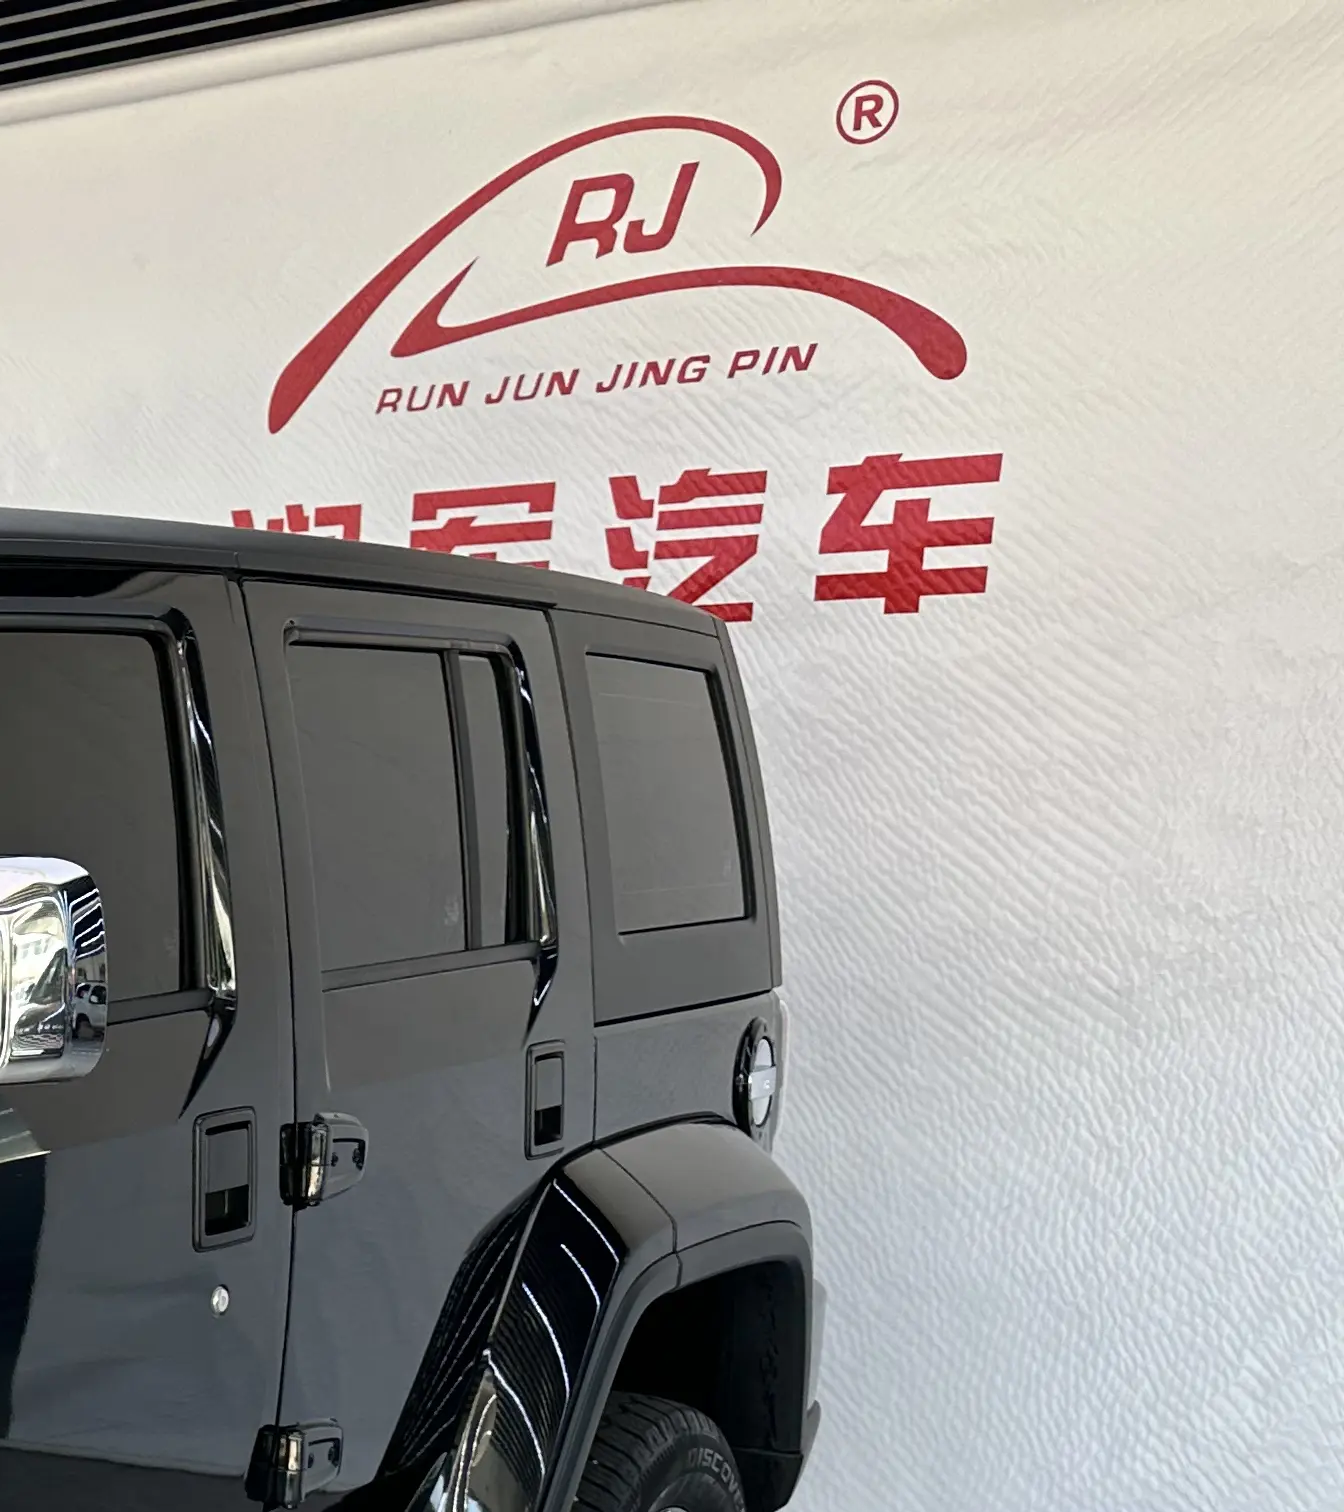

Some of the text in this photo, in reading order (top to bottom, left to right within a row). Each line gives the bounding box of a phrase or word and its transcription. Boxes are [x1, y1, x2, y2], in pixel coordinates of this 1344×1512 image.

[546, 161, 700, 267] RJ
[376, 343, 818, 414] RUN JUN JING PIN
[231, 453, 1004, 621] 军汽车
